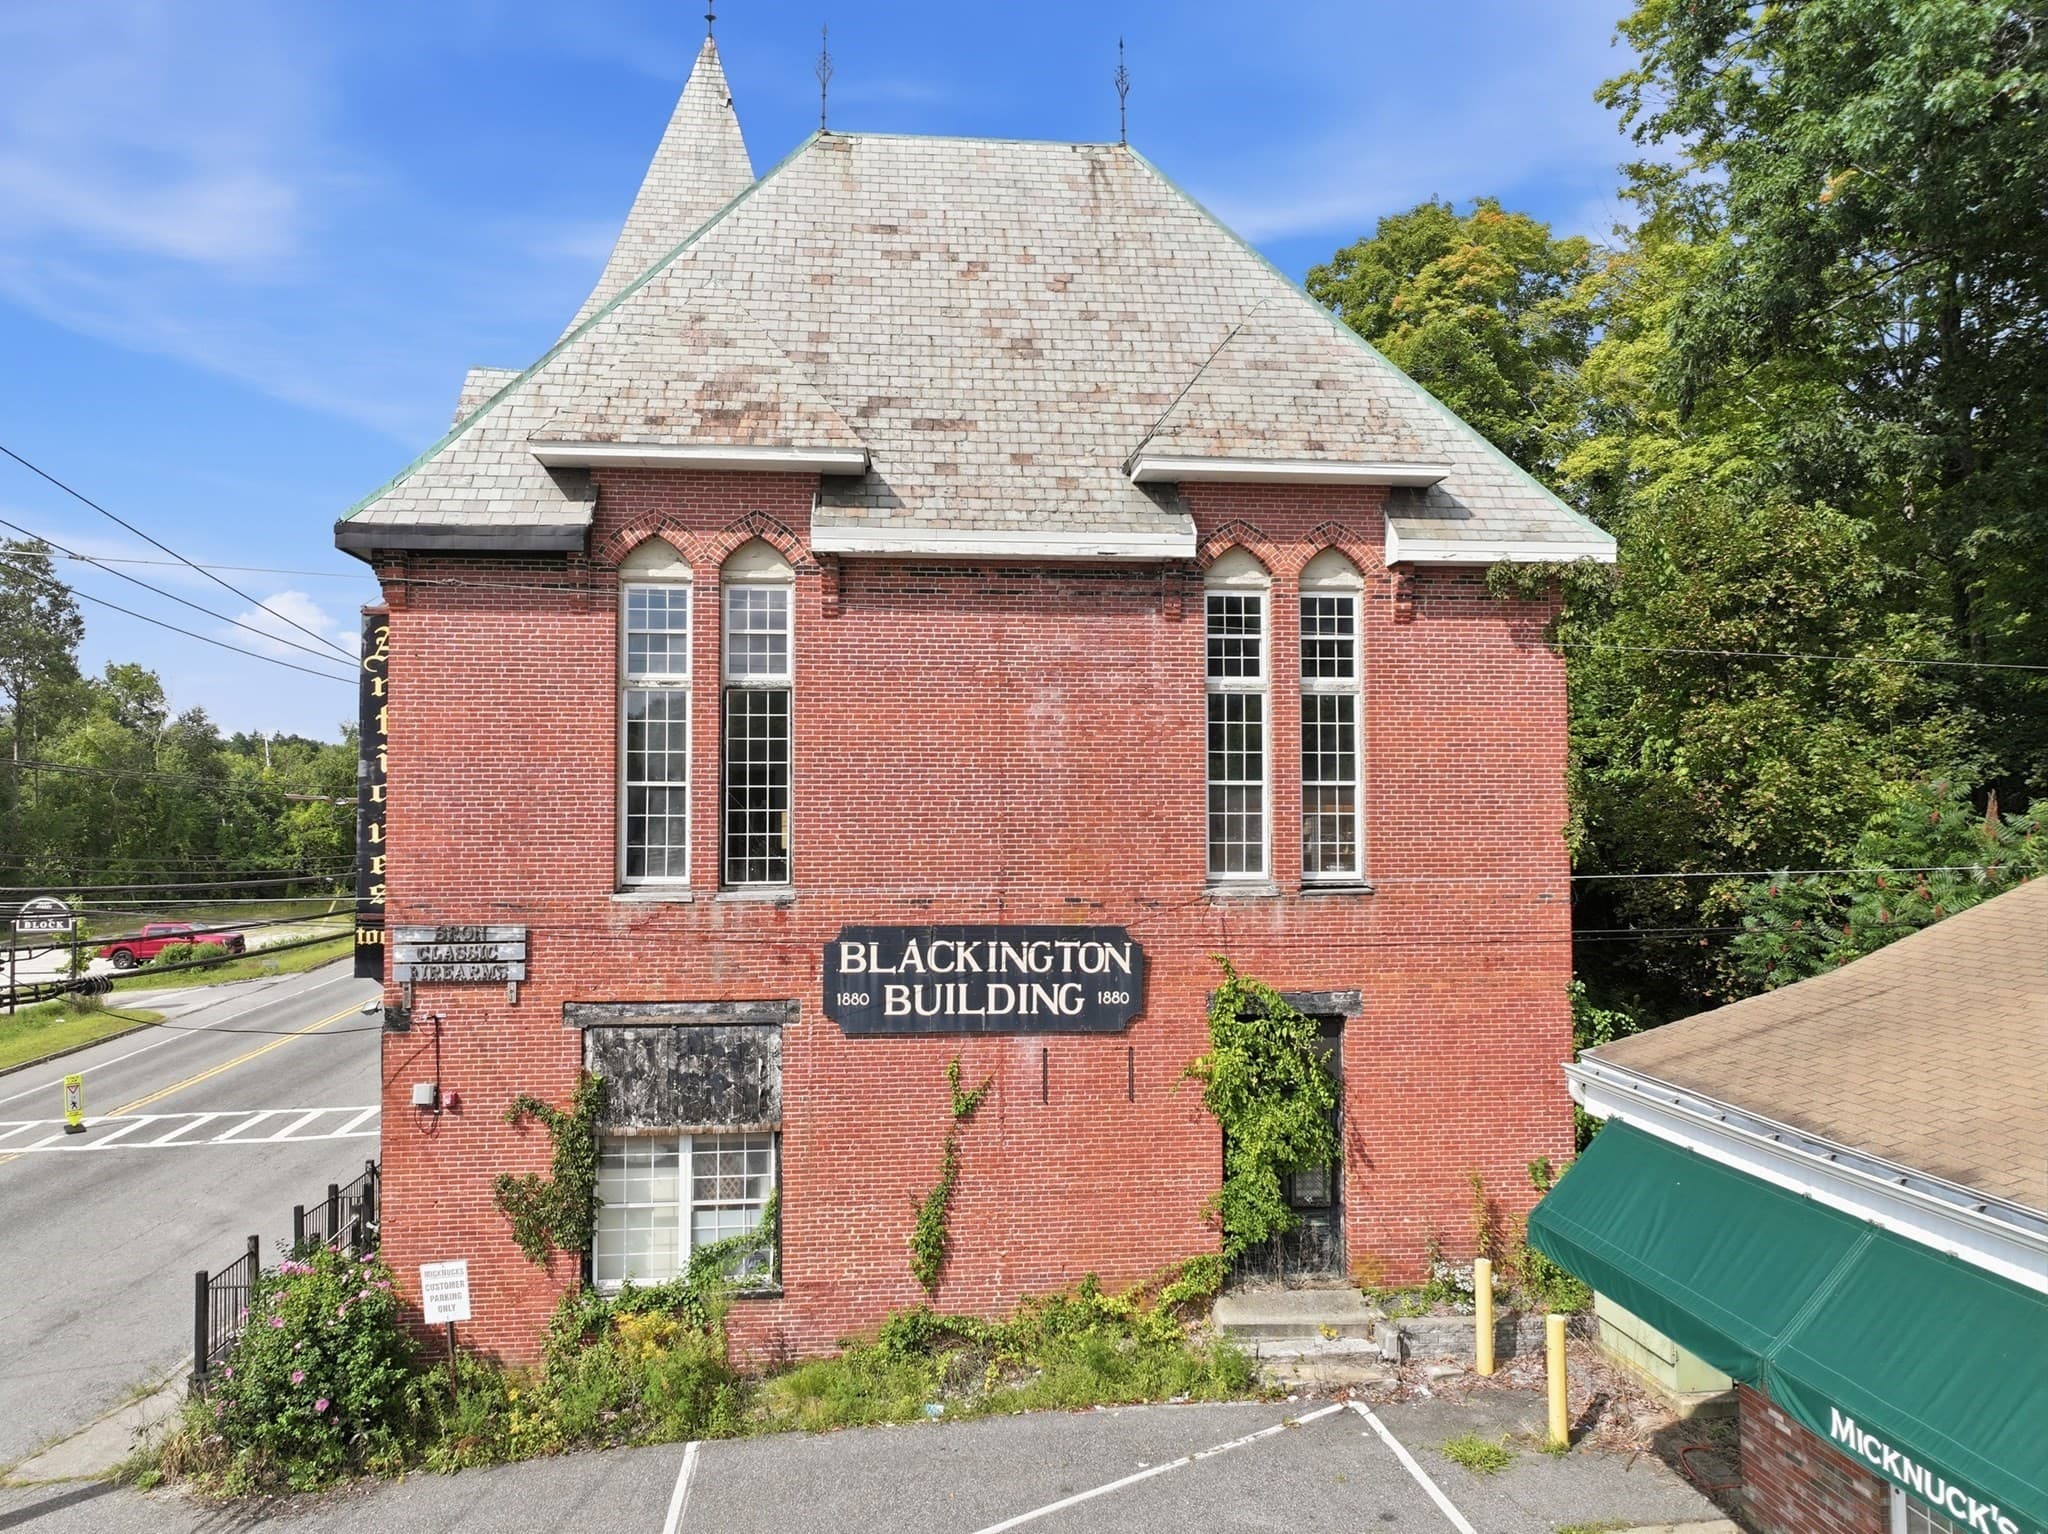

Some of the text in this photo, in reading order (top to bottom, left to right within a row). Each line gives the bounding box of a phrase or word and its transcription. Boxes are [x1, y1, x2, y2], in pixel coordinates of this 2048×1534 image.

[416, 944, 499, 962] CLASSIC
[839, 938, 1132, 974] BLACKINGTON
[409, 964, 509, 981] FIREARMS
[836, 983, 1130, 1016] 1880 BUILDING 1880
[425, 1281, 465, 1291] CUSTOMER
[430, 1292, 463, 1303] PARKING
[438, 1304, 456, 1313] ONLY
